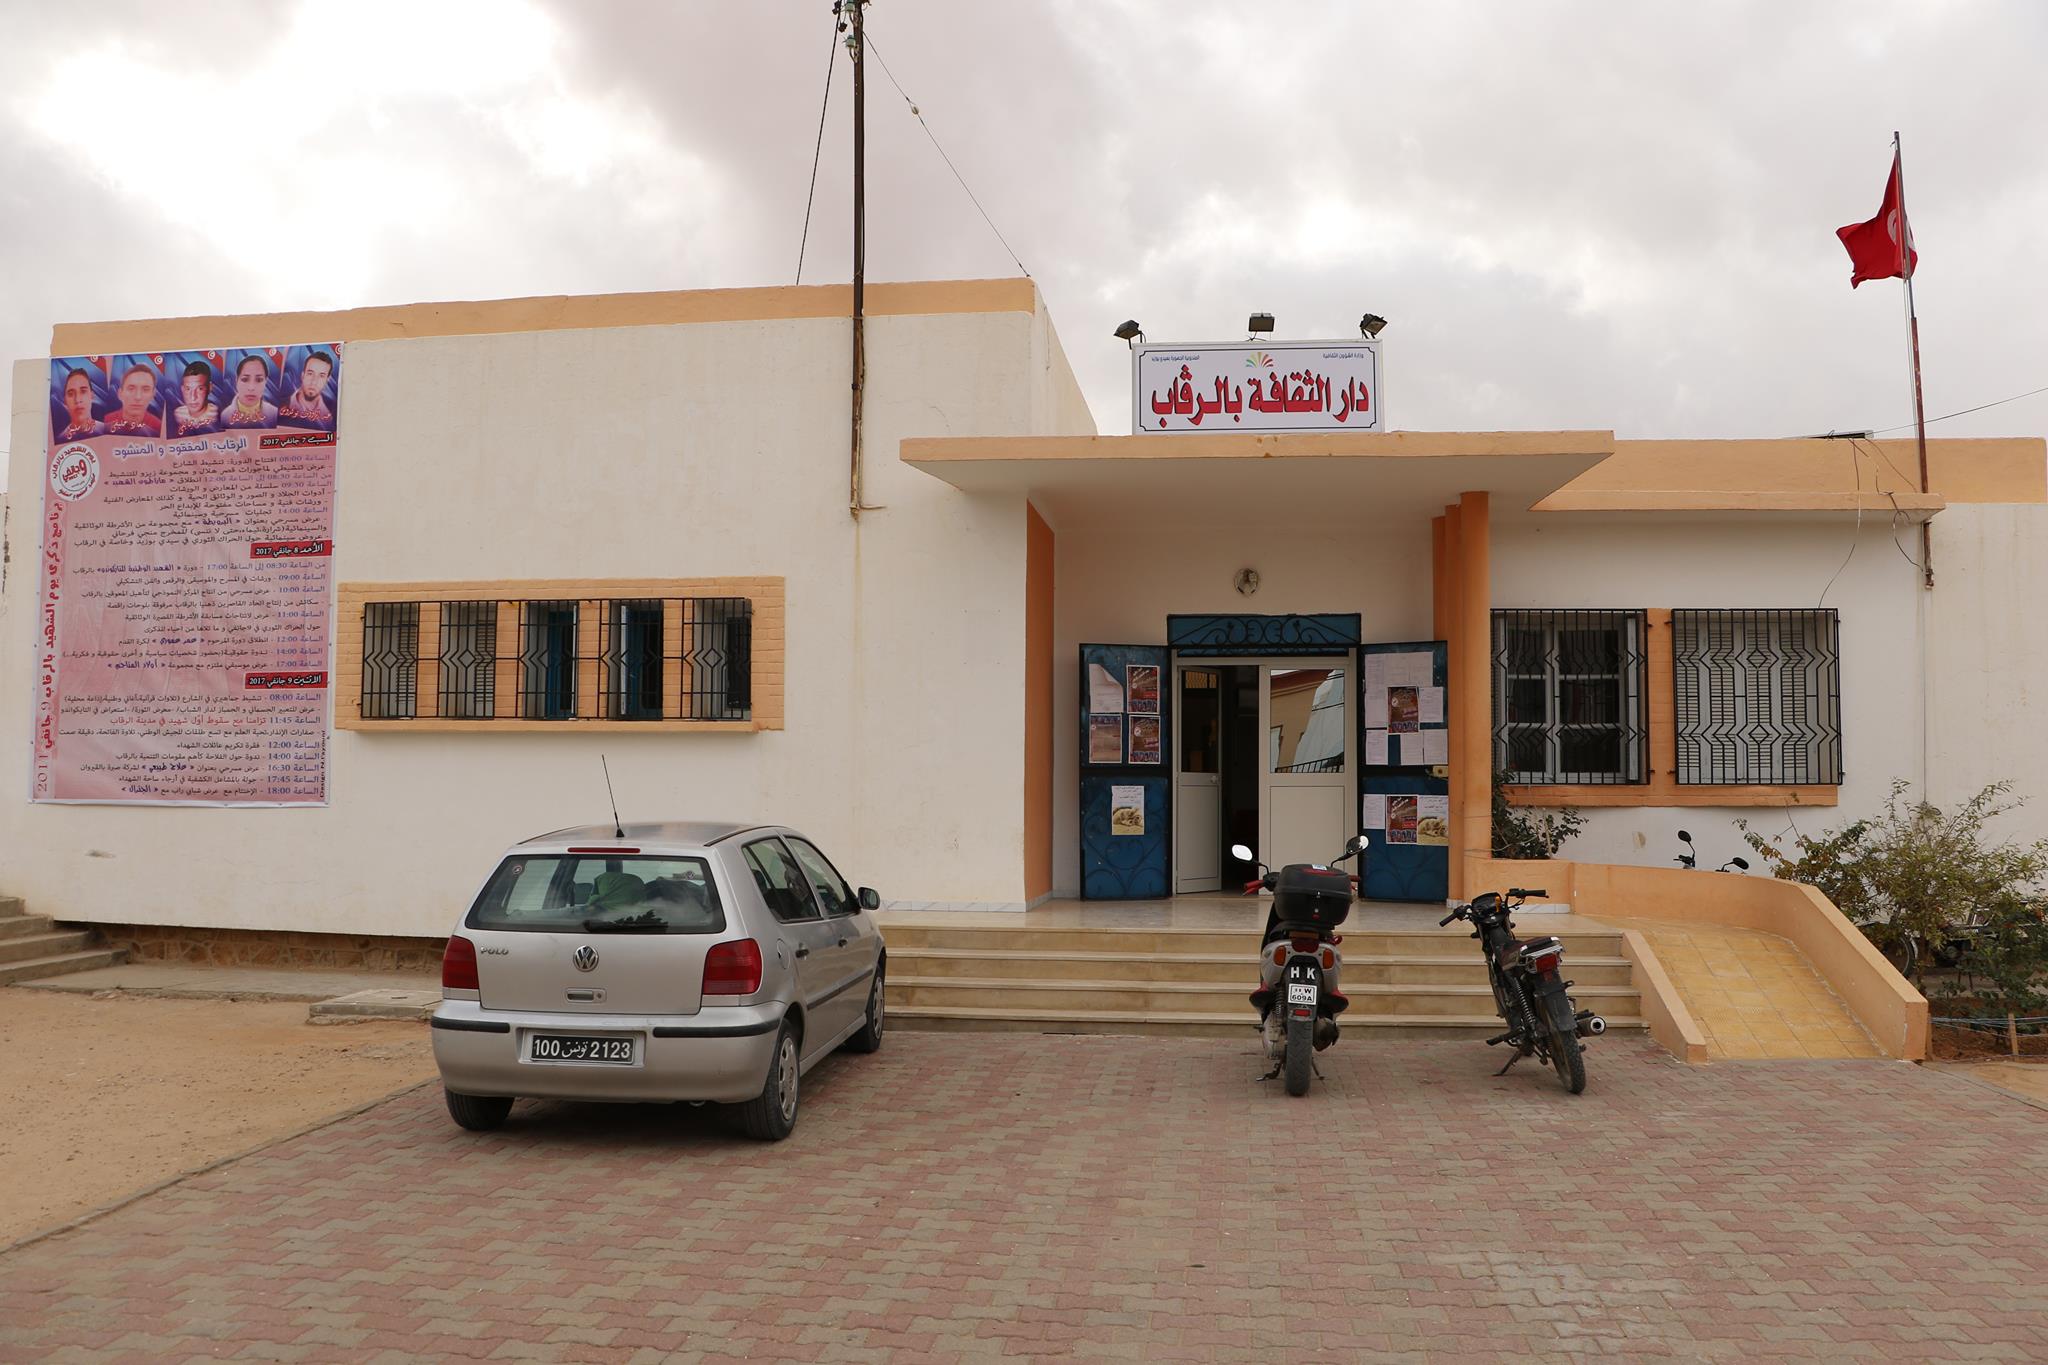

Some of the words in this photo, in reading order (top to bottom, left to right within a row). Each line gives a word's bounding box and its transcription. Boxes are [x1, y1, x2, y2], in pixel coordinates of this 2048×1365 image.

[1248, 369, 1332, 414] الثقافة
[1333, 376, 1369, 422] دار
[170, 440, 208, 456] المفقود
[214, 439, 246, 452] الرقاب:
[280, 438, 300, 447] جانفي
[114, 444, 153, 458] المنشود
[158, 447, 164, 456] و
[50, 502, 62, 538] برنامج
[47, 541, 60, 575] ذكرى
[273, 549, 292, 557] جانفي
[50, 579, 60, 601] يوم
[45, 603, 58, 648] الشهيد
[42, 654, 56, 698] بالرقاب
[266, 677, 286, 688] جانفي
[295, 693, 320, 701] الساعة
[41, 701, 51, 710] 9
[111, 716, 133, 724] الرقاب
[135, 716, 156, 724] مدينة
[159, 718, 165, 726] في
[233, 719, 243, 727] مع
[295, 716, 320, 724] الساعة
[42, 715, 55, 748] جانفي
[294, 752, 320, 760] الساعة
[38, 754, 48, 792] 2011
[293, 764, 319, 772] الساعة
[480, 946, 509, 956] POLO
[534, 1038, 560, 1057] 100
[561, 1039, 589, 1059] تونس
[590, 1041, 631, 1059] 2123
